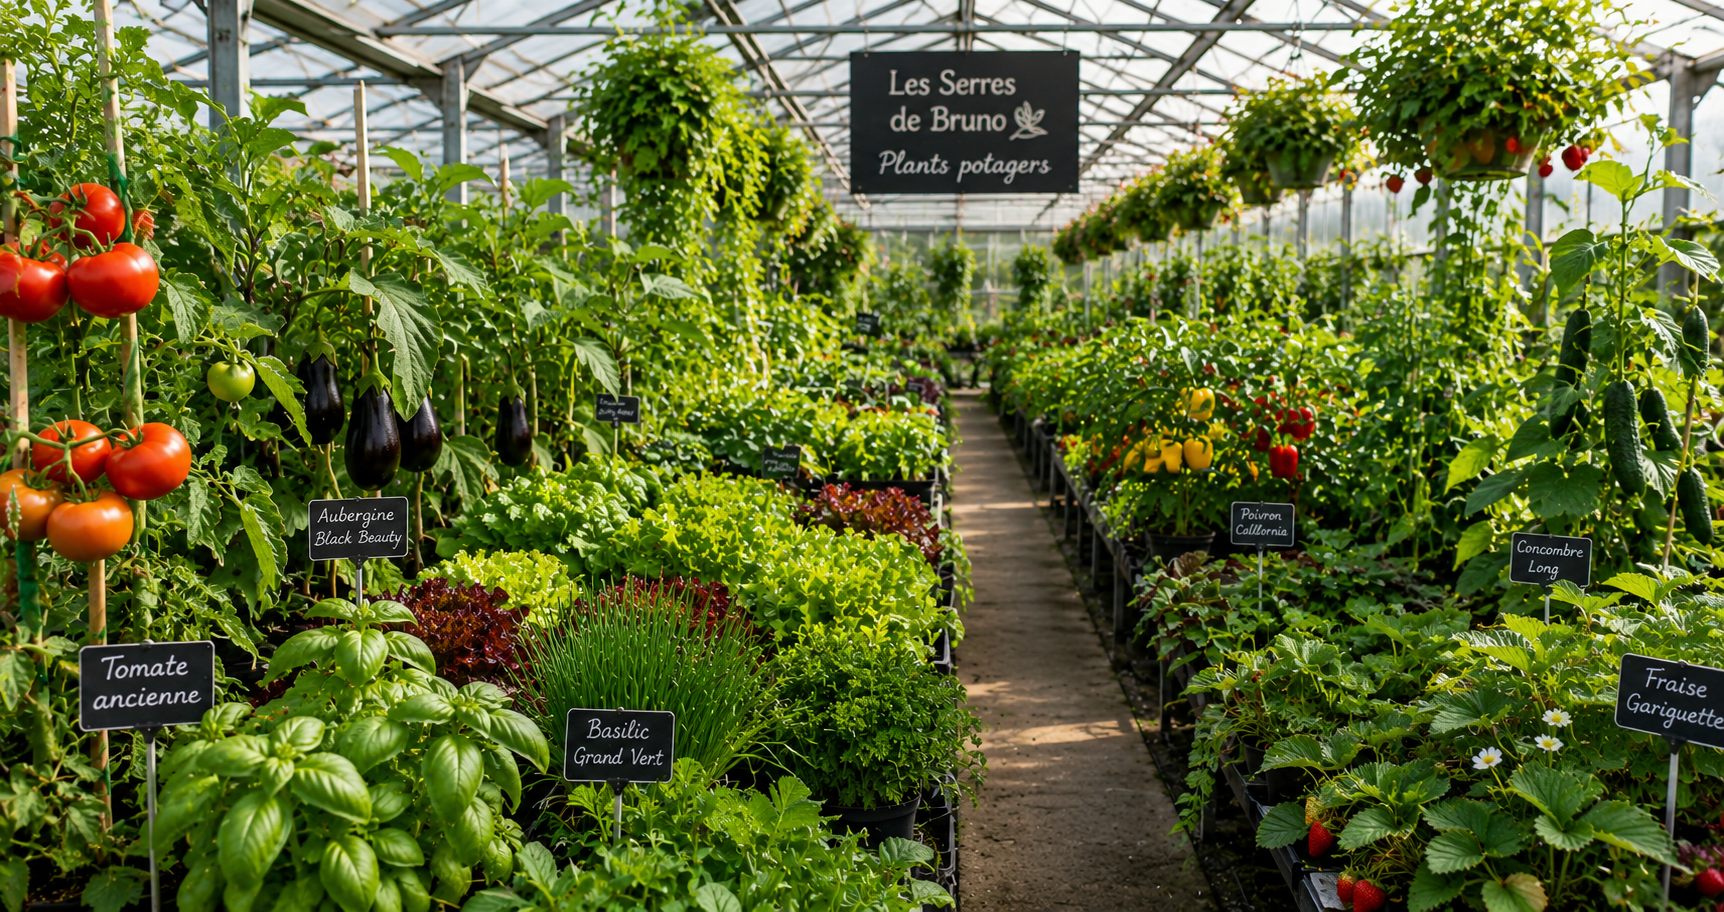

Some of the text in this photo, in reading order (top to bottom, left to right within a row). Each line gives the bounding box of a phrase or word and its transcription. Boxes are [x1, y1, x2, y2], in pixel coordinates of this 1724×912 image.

[890, 69, 1015, 95] Les Serres
[891, 106, 1006, 131] de Bruno
[880, 150, 1051, 184] Plants potagers
[318, 507, 394, 528] Aubergine
[1241, 508, 1281, 520] Poivron
[314, 530, 402, 549] Black Beauty
[1516, 539, 1584, 558] Concombre
[1528, 560, 1559, 580] Long
[101, 655, 188, 680] Tomate
[1645, 667, 1708, 698] Fraise
[93, 688, 201, 710] ancienne
[1626, 692, 1724, 730] Gariguette
[587, 718, 649, 739] Basilic
[574, 747, 623, 766] Grand
